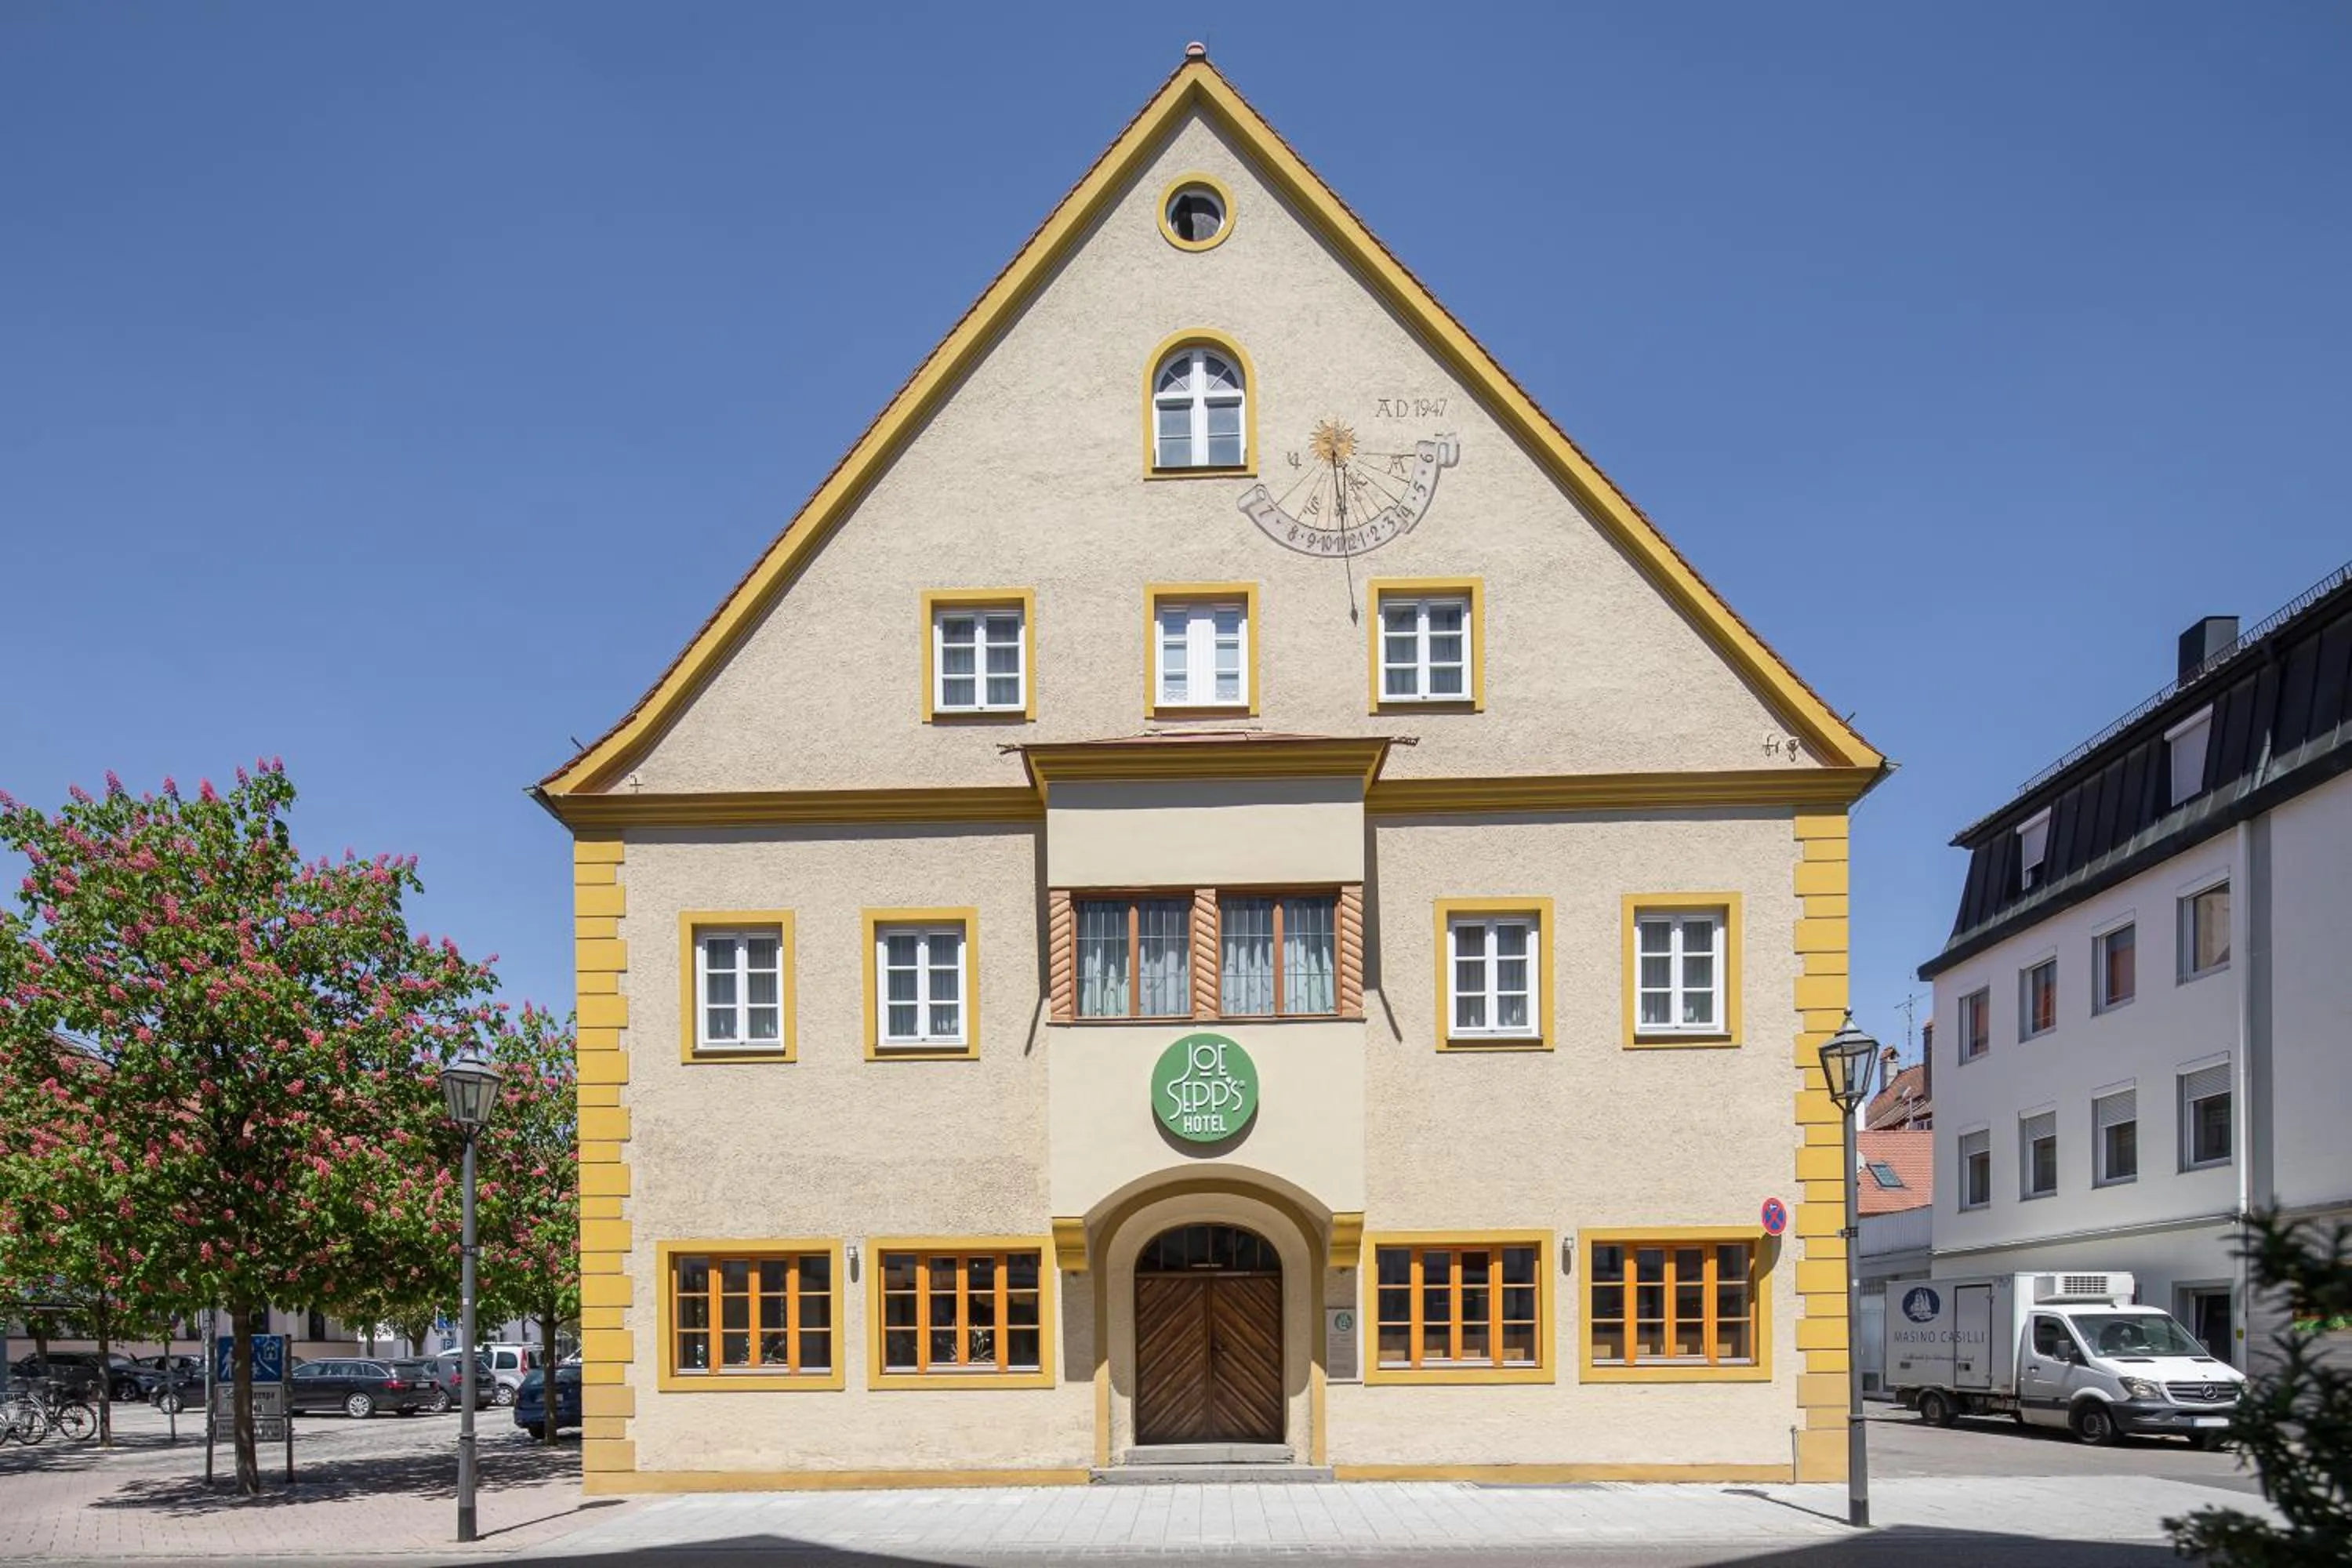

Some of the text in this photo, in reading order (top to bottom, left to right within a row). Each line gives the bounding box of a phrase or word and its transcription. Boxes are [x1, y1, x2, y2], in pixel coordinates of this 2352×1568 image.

[1414, 398, 1448, 418] 1947
[1287, 525, 1298, 542] 8
[1307, 533, 1316, 548] 9
[1370, 525, 1381, 541] 2
[1383, 516, 1396, 531] 3
[1414, 481, 1426, 497] 5
[1420, 453, 1435, 463] 6
[1182, 1043, 1228, 1078] JOE
[1183, 1115, 1228, 1133] HOTEL
[1893, 1330, 1985, 1343] MASINO CASILLI
